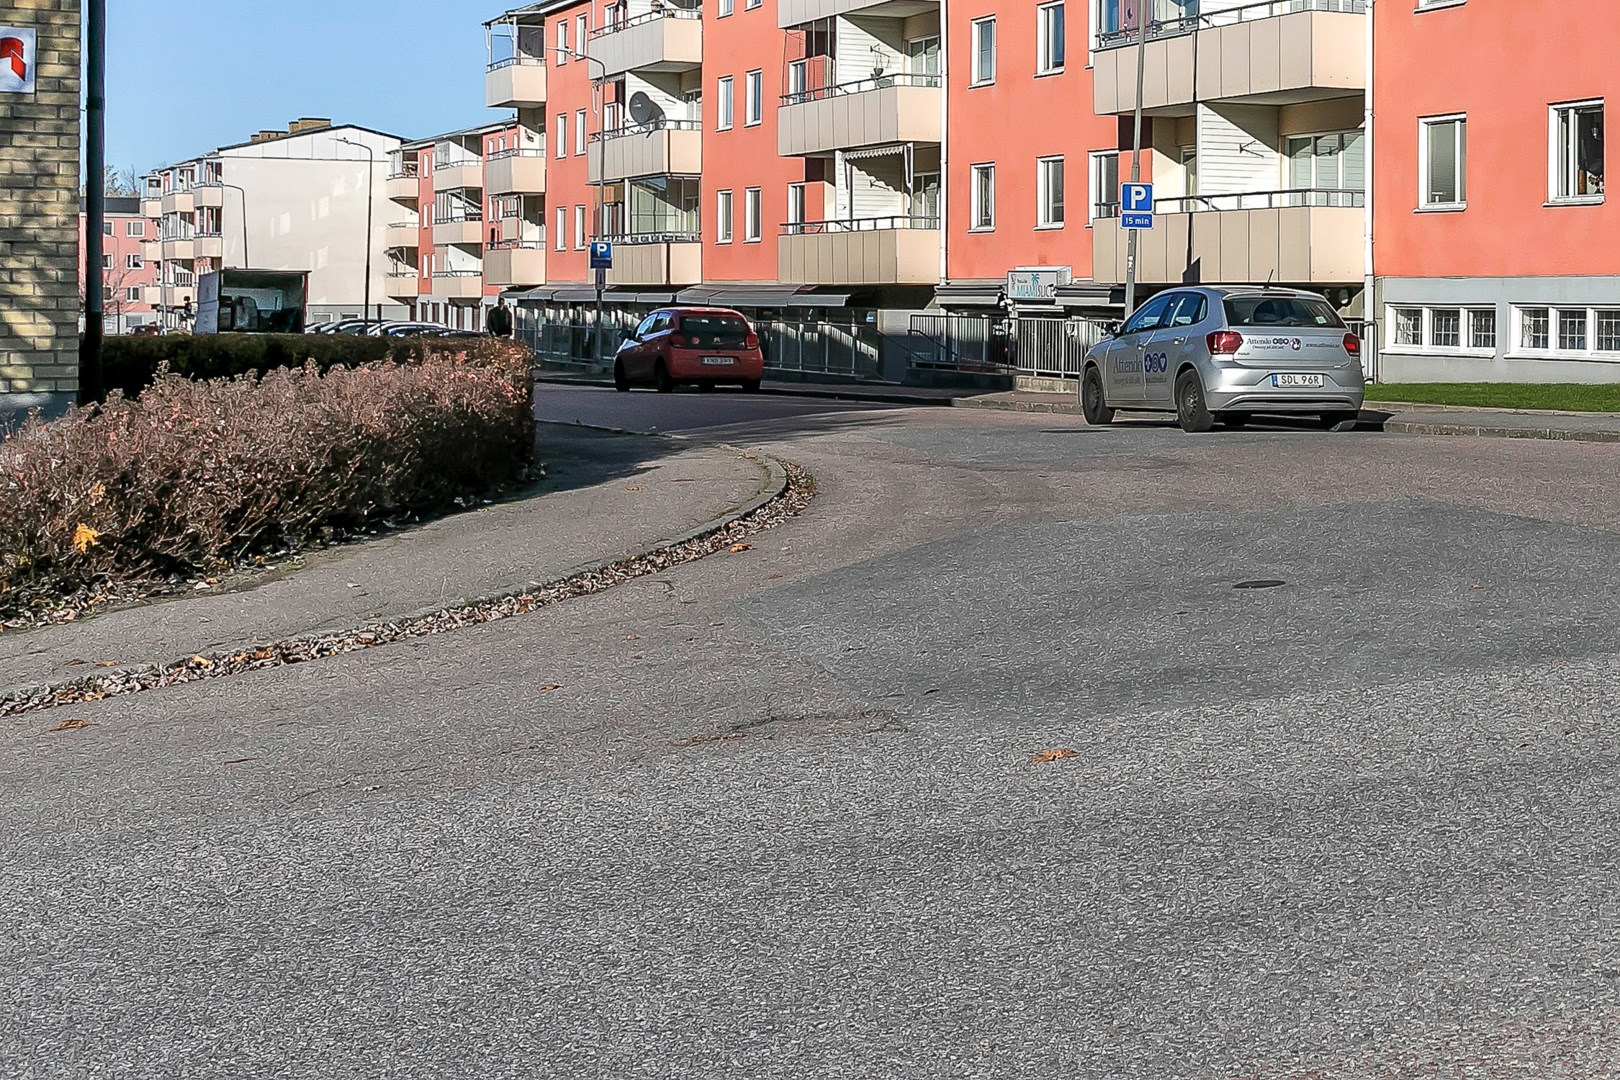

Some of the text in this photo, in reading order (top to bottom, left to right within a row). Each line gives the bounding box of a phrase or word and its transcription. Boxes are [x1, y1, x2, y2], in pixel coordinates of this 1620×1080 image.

[1130, 185, 1147, 210] P
[1125, 217, 1150, 225] 15 min
[596, 243, 608, 258] P
[1281, 375, 1320, 385] SDL 96R
